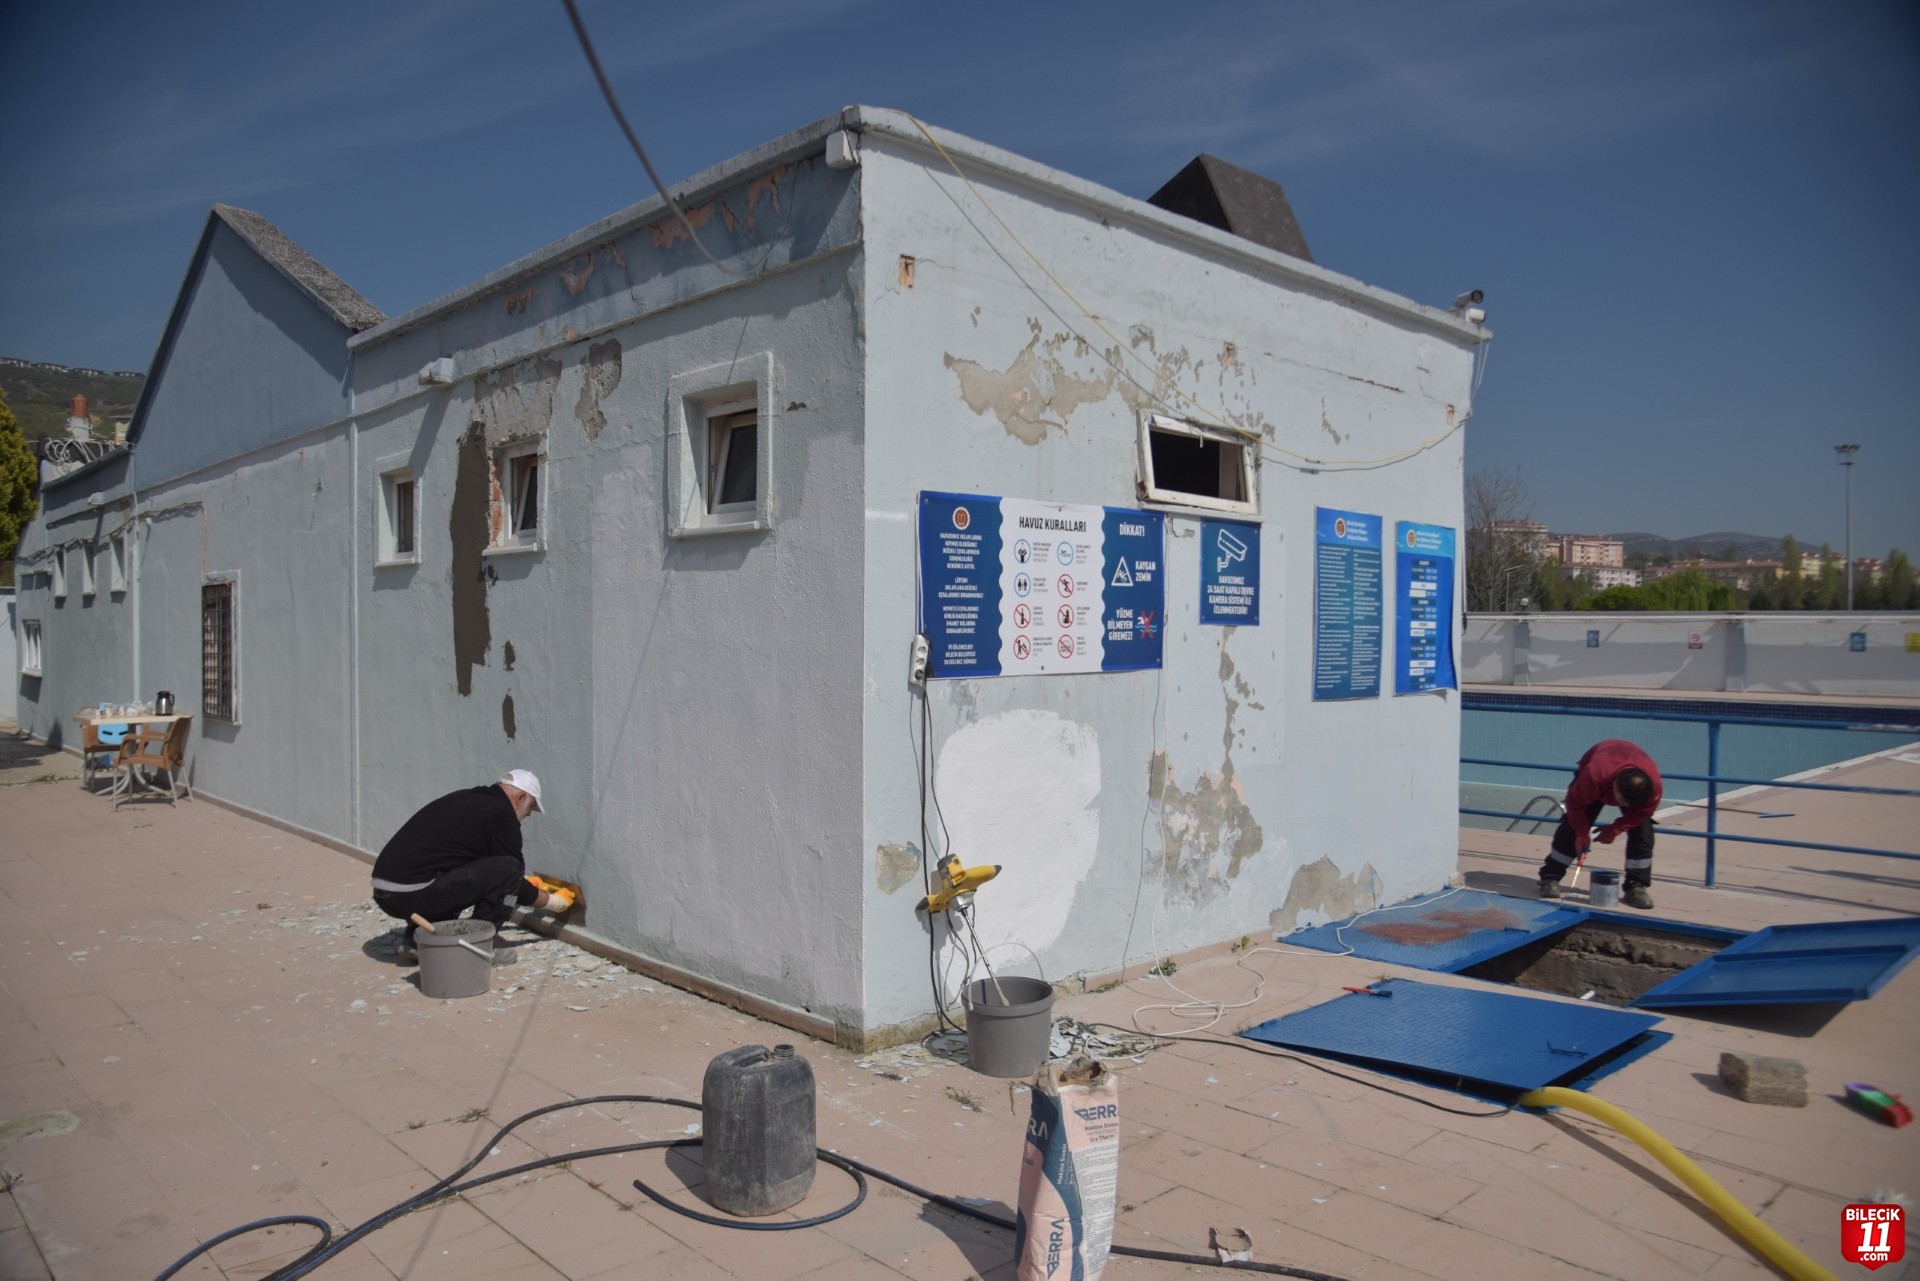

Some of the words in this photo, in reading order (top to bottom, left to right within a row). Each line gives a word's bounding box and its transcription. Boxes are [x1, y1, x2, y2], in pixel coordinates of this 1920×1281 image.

[1020, 517, 1043, 529] HAVUZ
[1045, 519, 1086, 532] KURALLARI
[1120, 522, 1145, 536] DİKKAT!
[1135, 561, 1156, 570] KAYGAN
[1136, 571, 1151, 581] ZEMİN
[1214, 585, 1225, 594] SAAT
[1209, 595, 1227, 604] KAMERA
[1116, 608, 1133, 618] YÜZME
[1108, 619, 1133, 629] BİLMEYEN
[1109, 630, 1133, 640] GİREMEZ!
